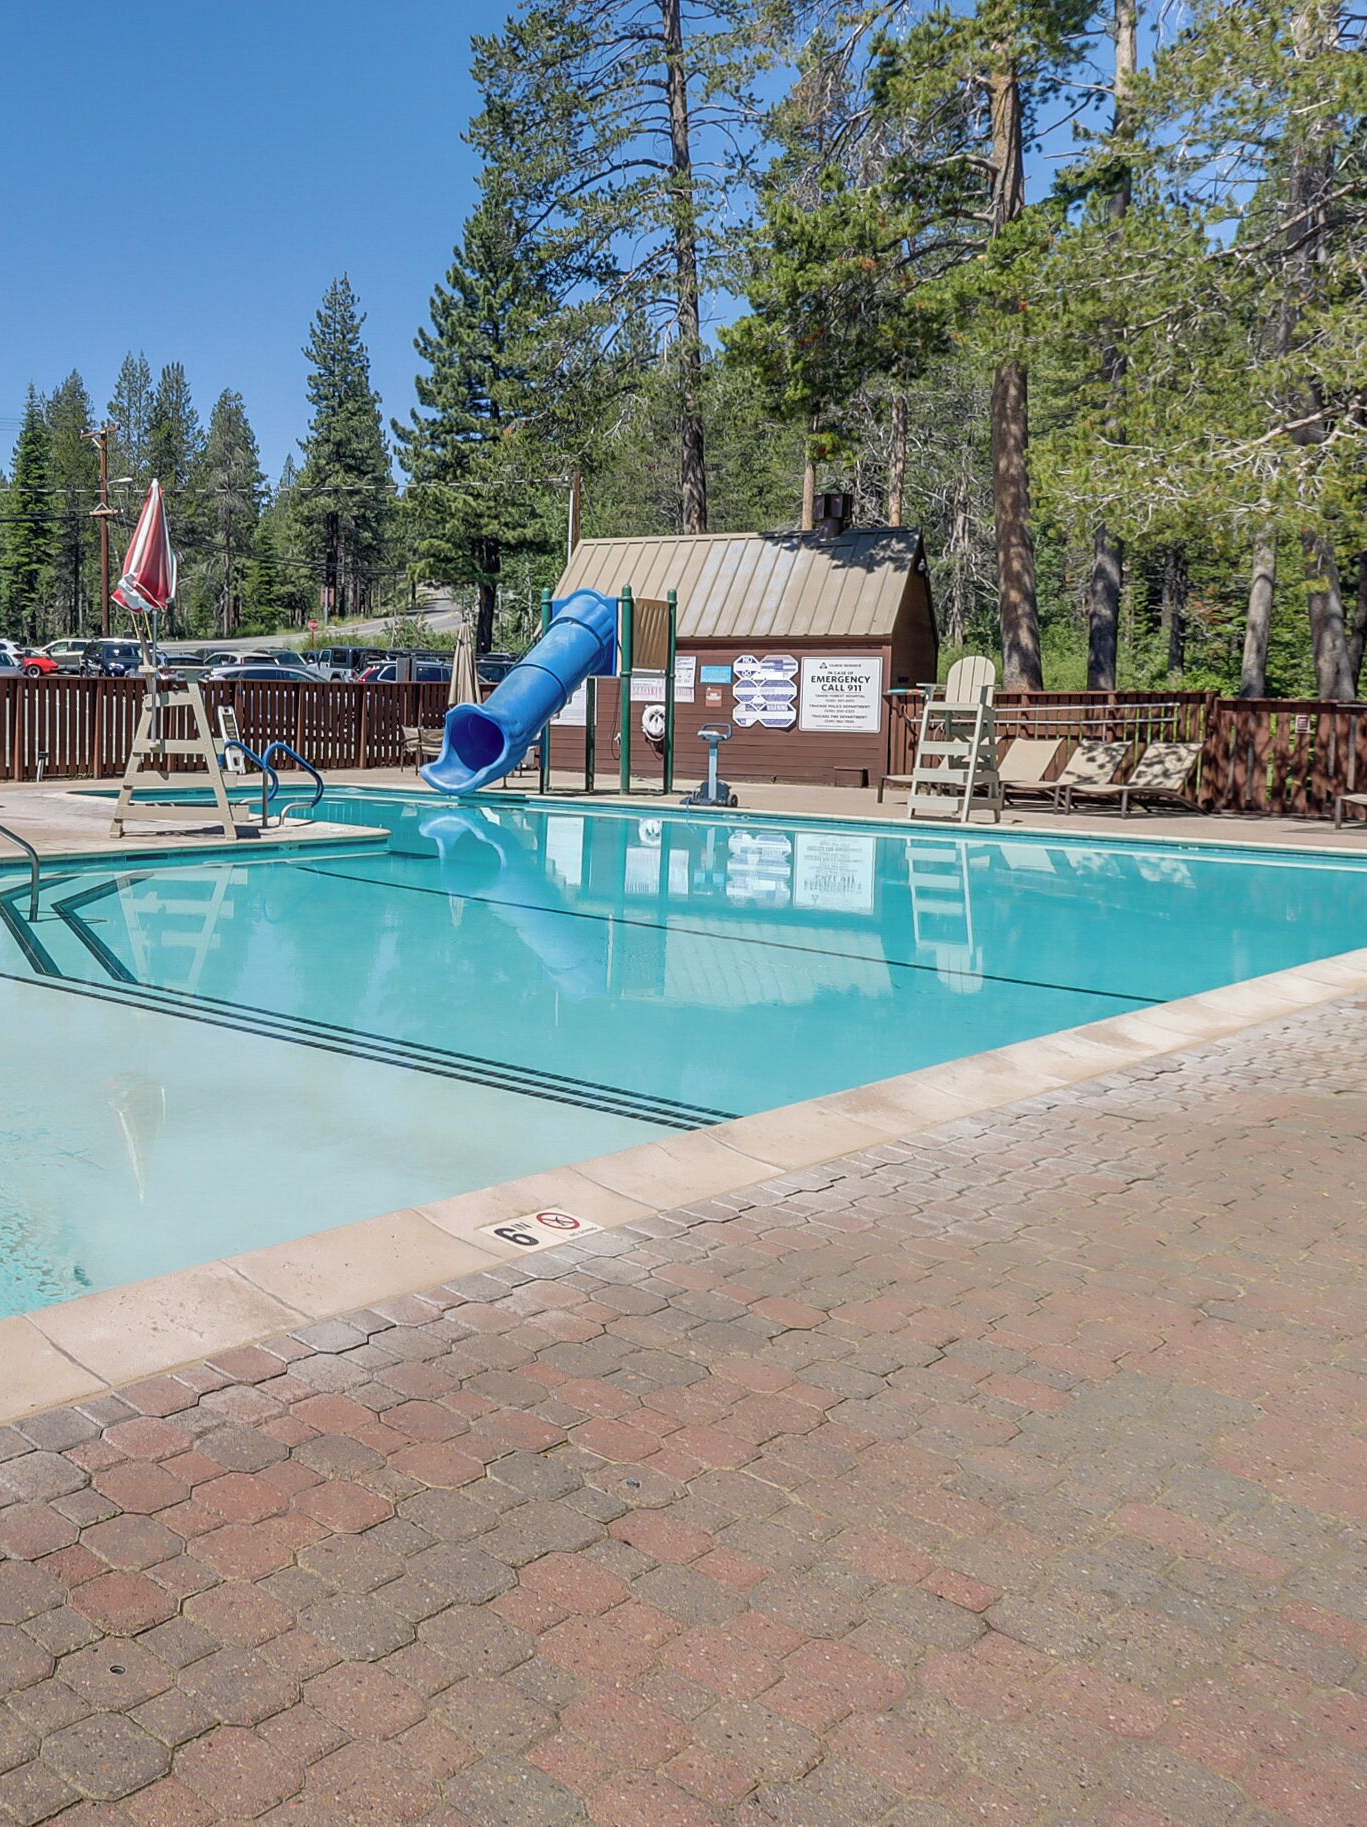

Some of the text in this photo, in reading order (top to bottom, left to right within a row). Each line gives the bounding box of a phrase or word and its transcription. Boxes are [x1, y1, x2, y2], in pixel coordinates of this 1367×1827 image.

[811, 675, 871, 683] EMERGENCY
[821, 684, 862, 692] CALL 911
[493, 1221, 539, 1246] 6 IN
